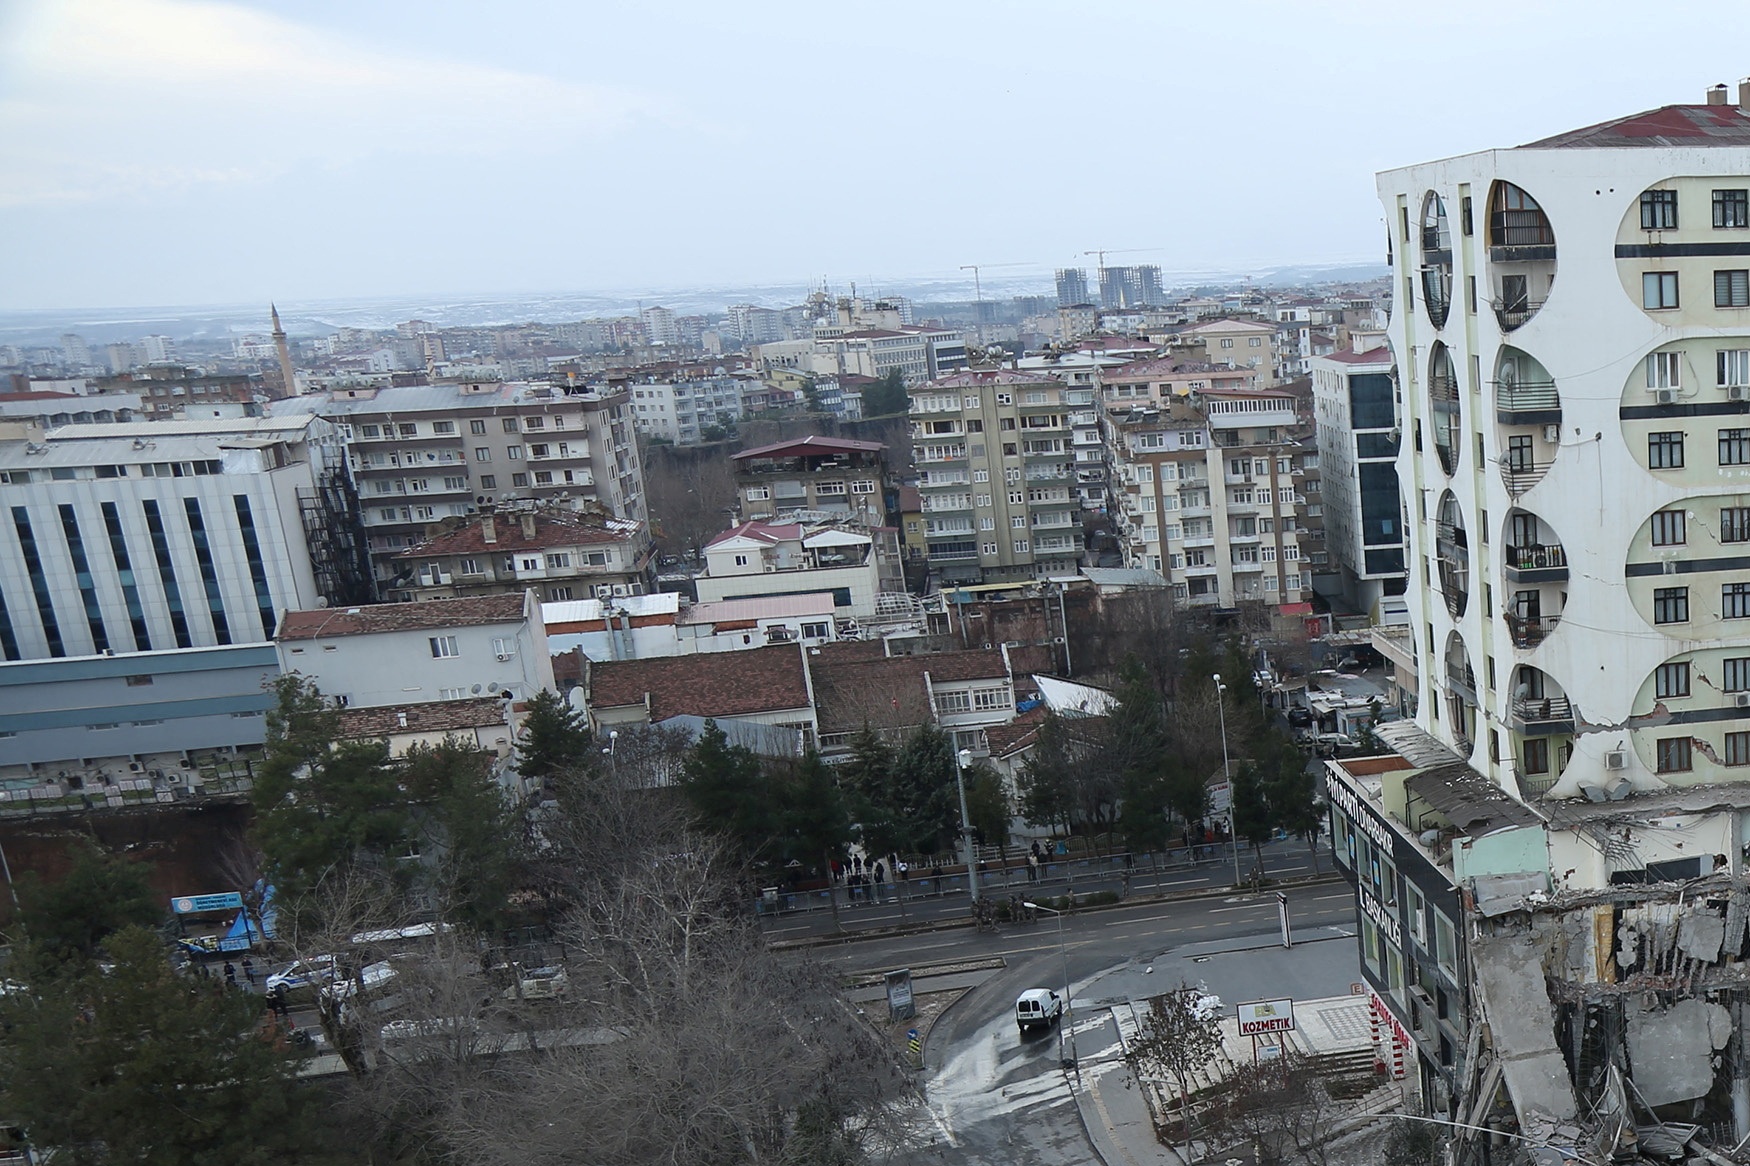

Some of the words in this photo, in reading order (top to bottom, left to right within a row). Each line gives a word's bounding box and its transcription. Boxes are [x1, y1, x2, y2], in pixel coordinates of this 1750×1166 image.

[1339, 783, 1360, 824] PARTİ
[1359, 804, 1394, 858] DİYARBAKIR
[1242, 1017, 1291, 1034] KOZMETİK
